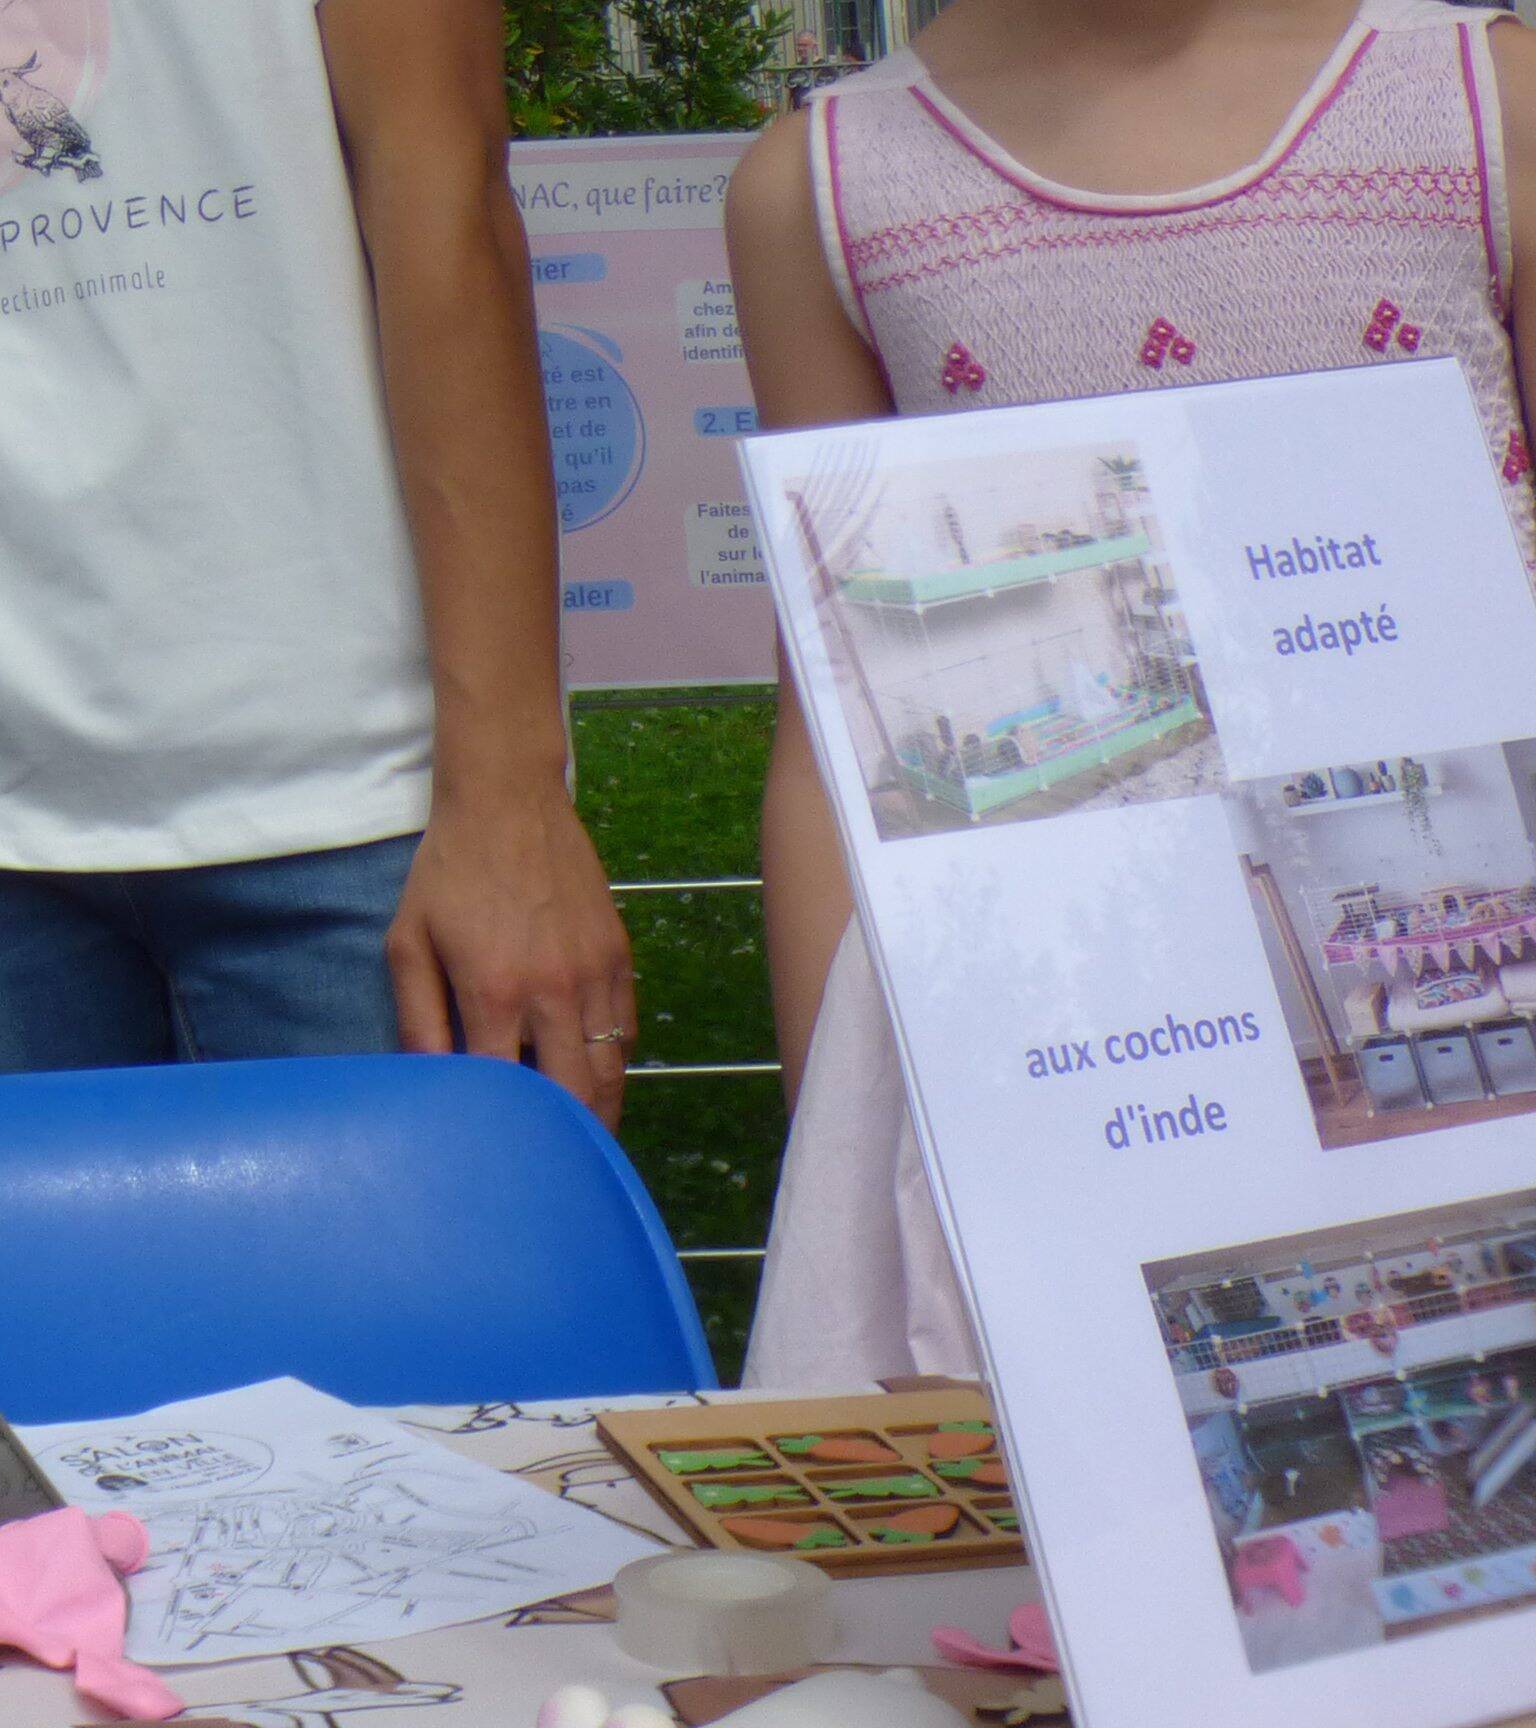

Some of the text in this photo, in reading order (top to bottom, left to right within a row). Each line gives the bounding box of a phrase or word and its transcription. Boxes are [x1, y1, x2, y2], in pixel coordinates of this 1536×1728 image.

[510, 174, 728, 216] NAC, que faire?
[0, 185, 258, 254] PROVENCE
[73, 262, 167, 302] animale
[693, 302, 736, 317] chez
[684, 324, 718, 339] afin
[570, 366, 605, 383] est
[548, 395, 612, 412] tre en
[552, 420, 607, 439] et de
[702, 412, 726, 434] 2.
[564, 446, 613, 470] qu'il
[558, 479, 597, 498] pas
[697, 502, 751, 519] Faites
[728, 524, 749, 539] de
[718, 548, 747, 562] sur
[1245, 534, 1382, 581] Habitat
[563, 584, 614, 609] aler
[1273, 603, 1399, 656] adapté
[1025, 1011, 1261, 1079] aux cochons
[1104, 1093, 1228, 1151] d'inde
